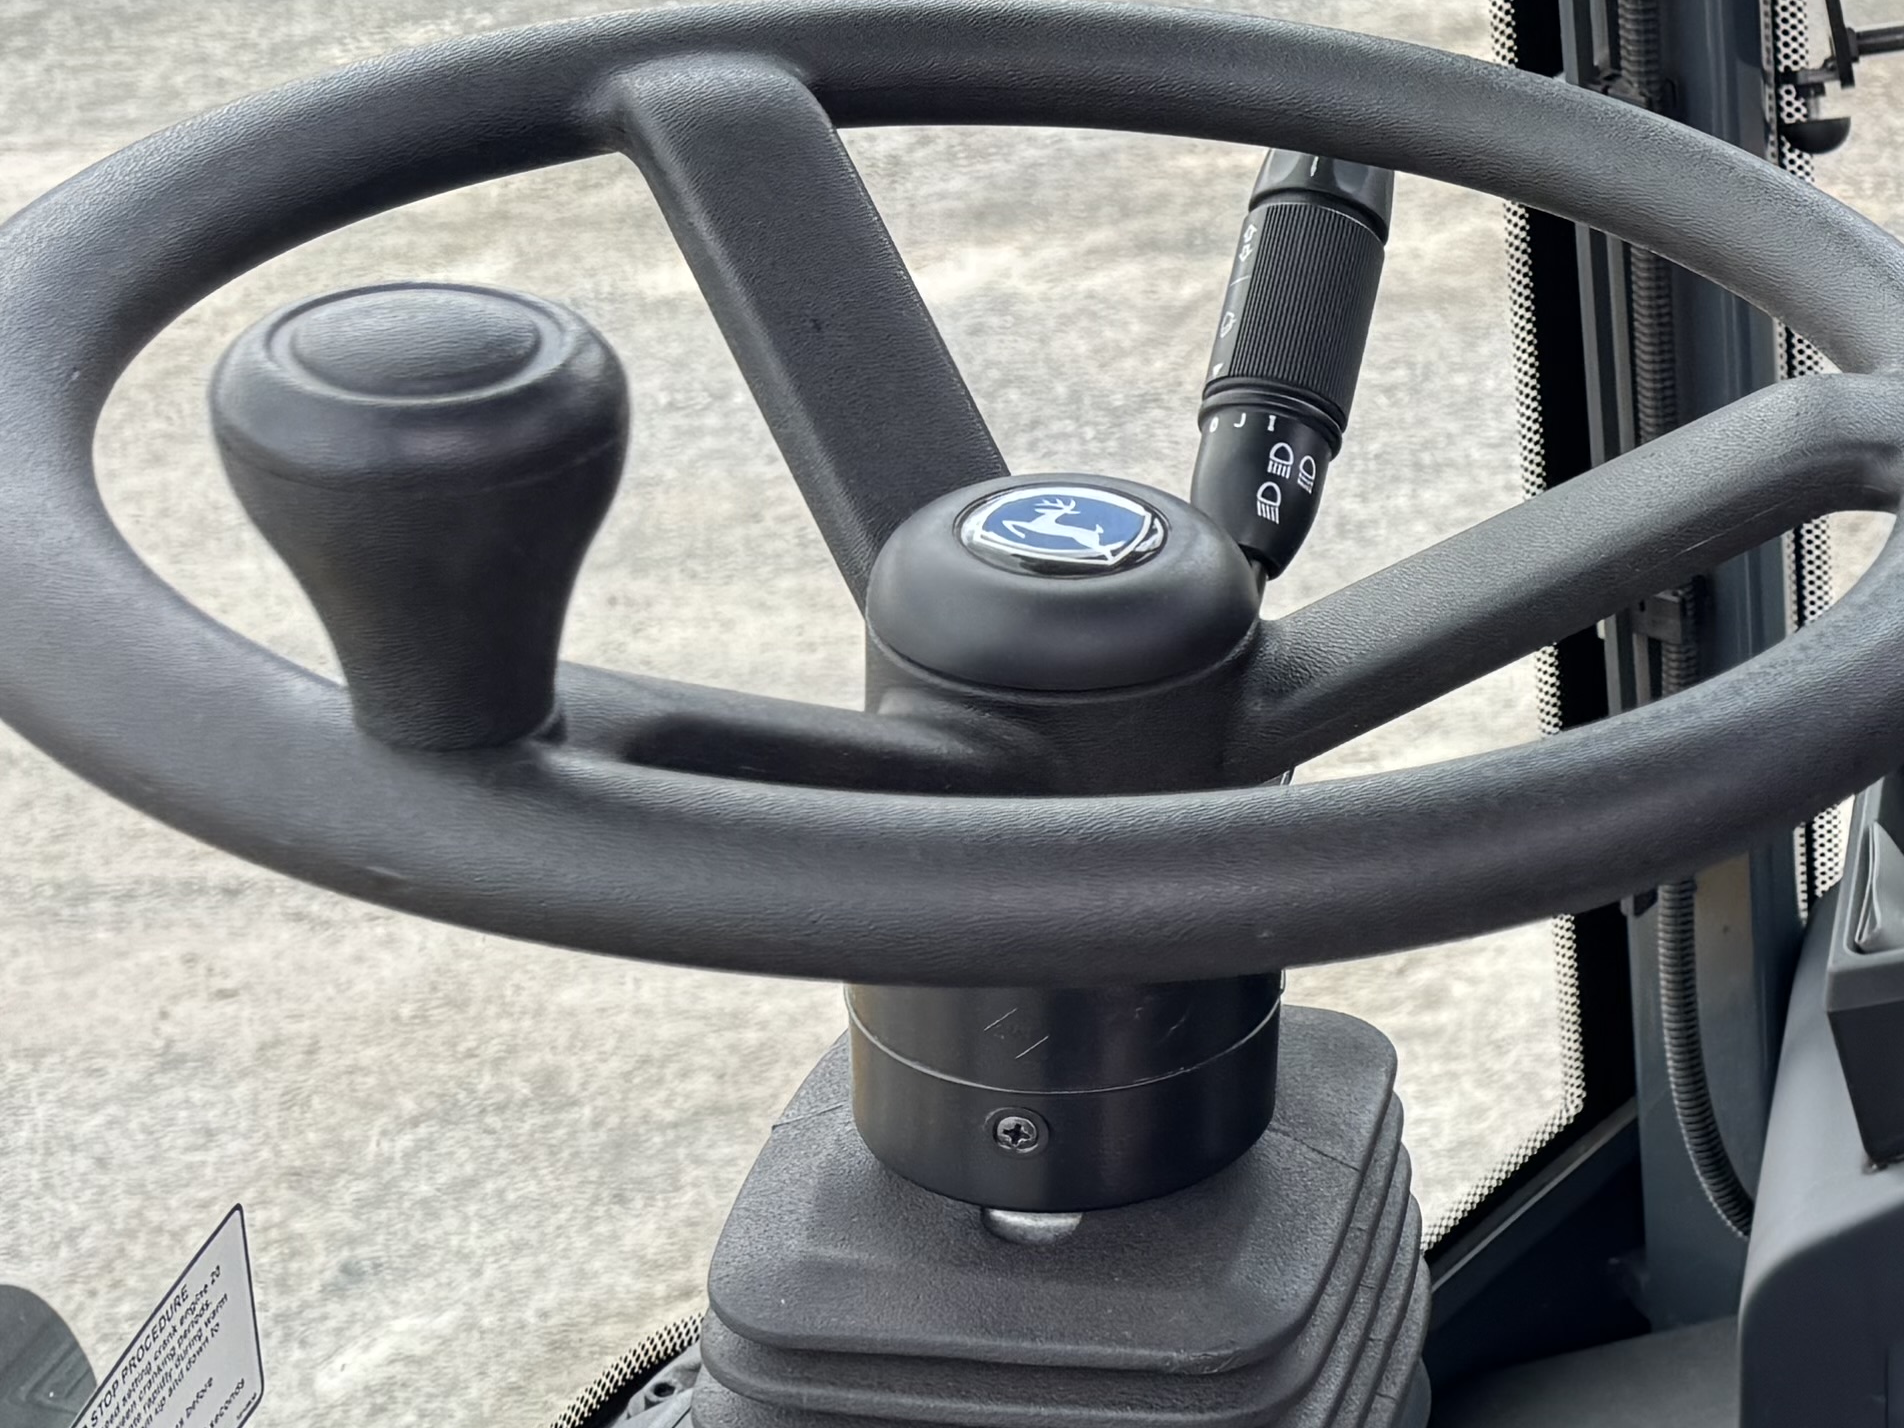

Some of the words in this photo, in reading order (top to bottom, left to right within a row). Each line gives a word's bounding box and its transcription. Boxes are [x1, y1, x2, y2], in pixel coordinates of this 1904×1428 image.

[120, 1281, 188, 1386] PROCEDURE
[121, 1356, 152, 1411] setting
[153, 1321, 177, 1364] crank
[179, 1278, 209, 1330] engine
[137, 1341, 176, 1405] cranking
[142, 1363, 173, 1417] rapidly
[174, 1322, 203, 1372] during
[203, 1289, 227, 1332] warm
[154, 1392, 167, 1420] up
[167, 1365, 184, 1401] and
[184, 1329, 209, 1375] down
[209, 1316, 220, 1341] to
[185, 1371, 213, 1421] before
